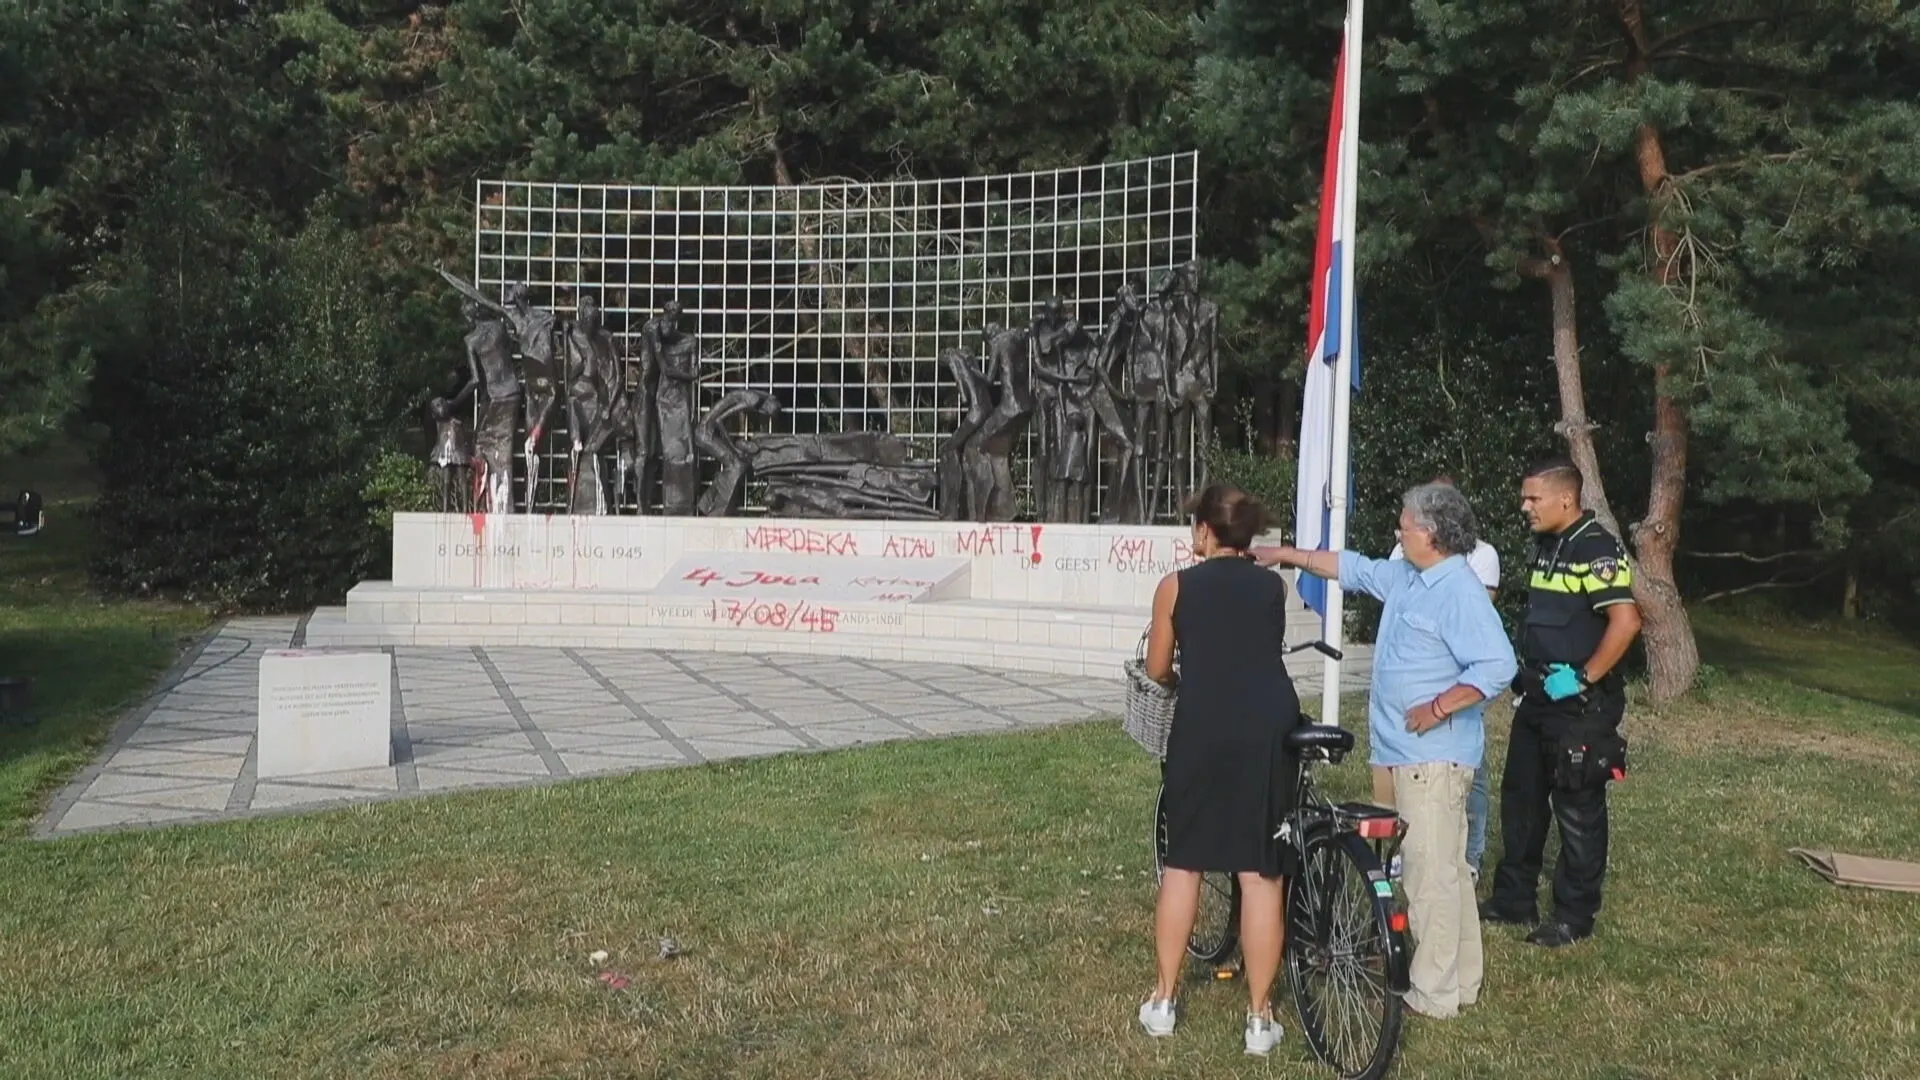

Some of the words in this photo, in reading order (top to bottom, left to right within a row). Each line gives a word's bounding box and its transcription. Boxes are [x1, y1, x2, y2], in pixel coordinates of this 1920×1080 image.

[438, 543, 447, 557] 8
[493, 545, 520, 557] 1941
[552, 545, 565, 558] 15
[573, 545, 604, 559] AUG
[612, 546, 642, 559] 1945
[745, 526, 858, 556] MERDEKA
[882, 535, 936, 558] ATAU
[957, 525, 1043, 564] MATI!
[1108, 535, 1154, 564] KAMI
[1055, 557, 1099, 572] GEEST
